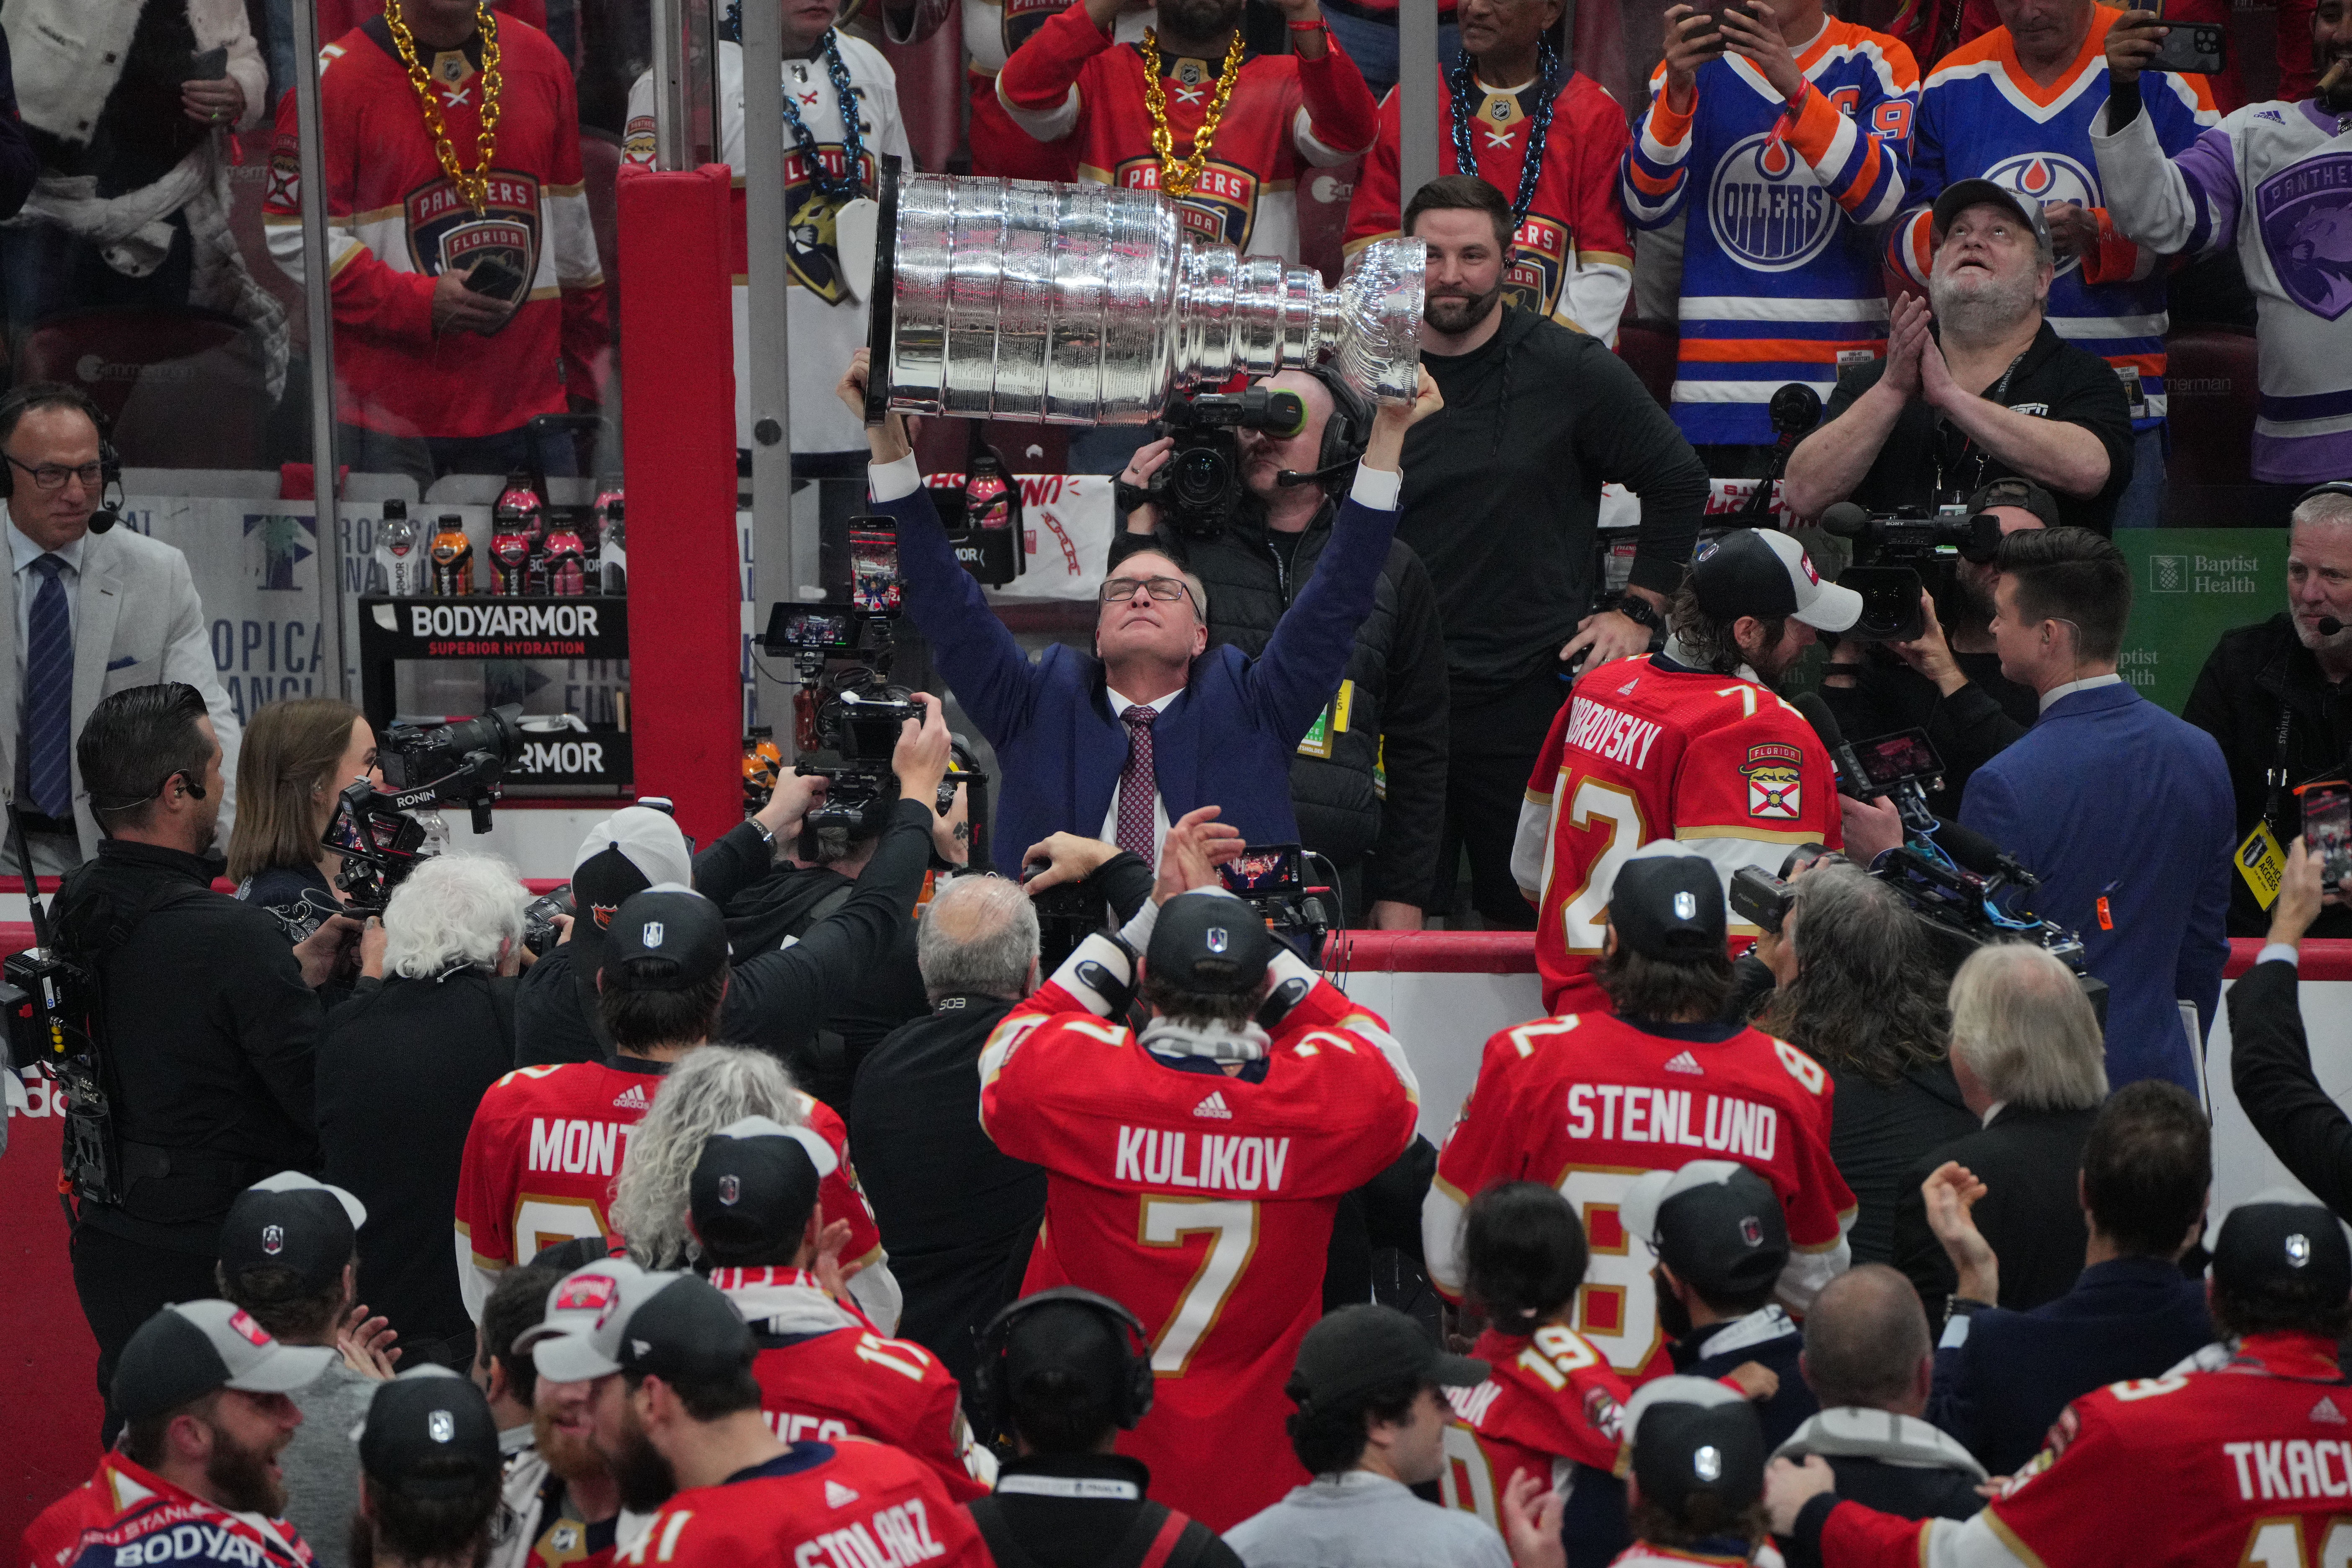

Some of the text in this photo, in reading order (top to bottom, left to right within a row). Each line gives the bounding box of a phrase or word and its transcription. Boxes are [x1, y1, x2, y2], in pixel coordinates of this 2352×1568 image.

[2254, 112, 2286, 125] adidas
[1130, 168, 1241, 198] PAERS
[420, 182, 526, 218] PANERS
[1723, 183, 1823, 254] OILERS
[454, 230, 519, 252] FLORIDA
[1999, 366, 2015, 392] STANLEY
[2195, 555, 2259, 576] Baptist
[2195, 577, 2256, 593] Health
[411, 606, 598, 635] BODYARMOR
[429, 641, 585, 655] SUPERIOR HYDRATION
[1754, 747, 1795, 758] FLORIDA
[397, 789, 436, 807] RONIN
[2259, 862, 2278, 892] ACCESS
[1773, 1038, 1825, 1096] 8
[613, 1098, 650, 1110] adidas
[1193, 1107, 1233, 1119] adidas
[1567, 1083, 1777, 1161] STENLUND
[1115, 1125, 1289, 1191] KULIKOV
[1137, 1194, 1259, 1378] 7
[1518, 1325, 1598, 1391] 19
[2224, 1440, 2352, 1500] TKAC
[795, 1497, 946, 1568] STOLARZ
